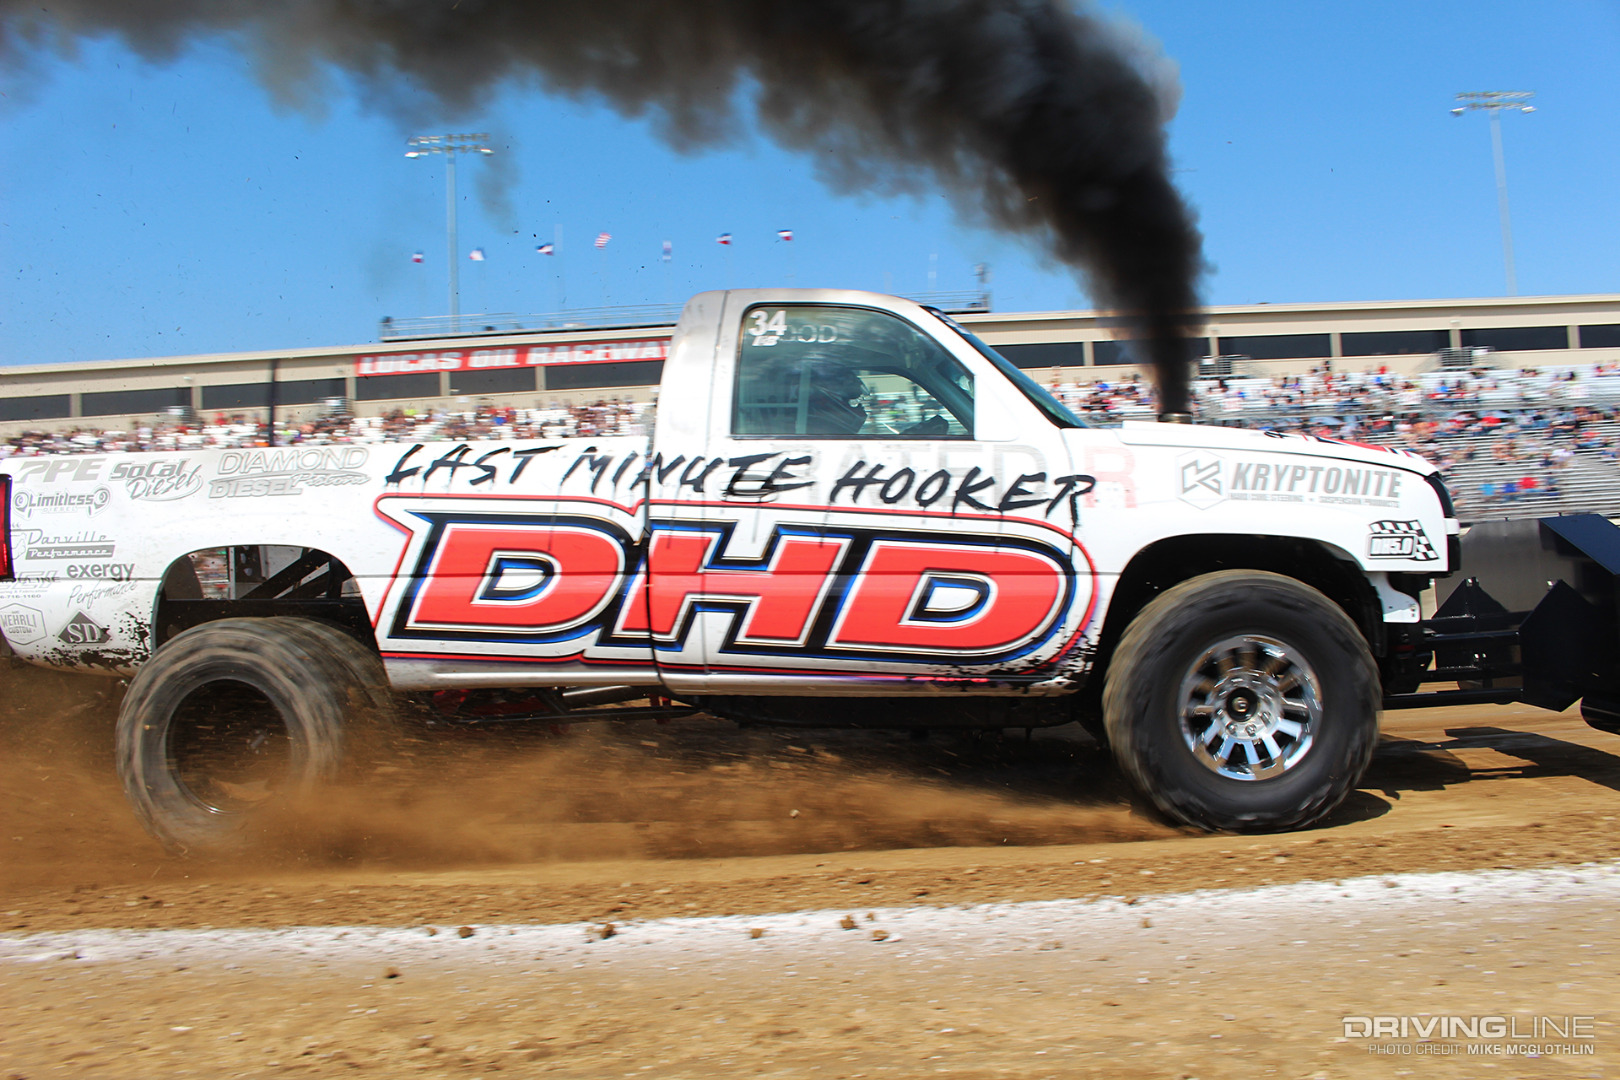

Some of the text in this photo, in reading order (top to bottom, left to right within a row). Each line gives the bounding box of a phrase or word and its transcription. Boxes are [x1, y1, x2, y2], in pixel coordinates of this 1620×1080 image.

[748, 310, 787, 336] 34
[358, 351, 462, 375] LUCAS
[468, 348, 520, 368] OIL
[14, 458, 107, 484] PPE
[109, 459, 189, 481] SoCal
[217, 447, 369, 475] DIAMOND
[128, 464, 202, 500] Diesel
[209, 478, 302, 498] DIESEL
[386, 444, 1096, 526] LAST MINUTE HOOKER
[1231, 462, 1402, 498] KRYPTONITE
[28, 492, 95, 507] Limitless
[26, 529, 115, 545] Danville
[28, 548, 113, 560] Performance
[66, 563, 135, 583] exergy
[390, 510, 1078, 664] DHD
[0, 614, 37, 628] WEHRLI
